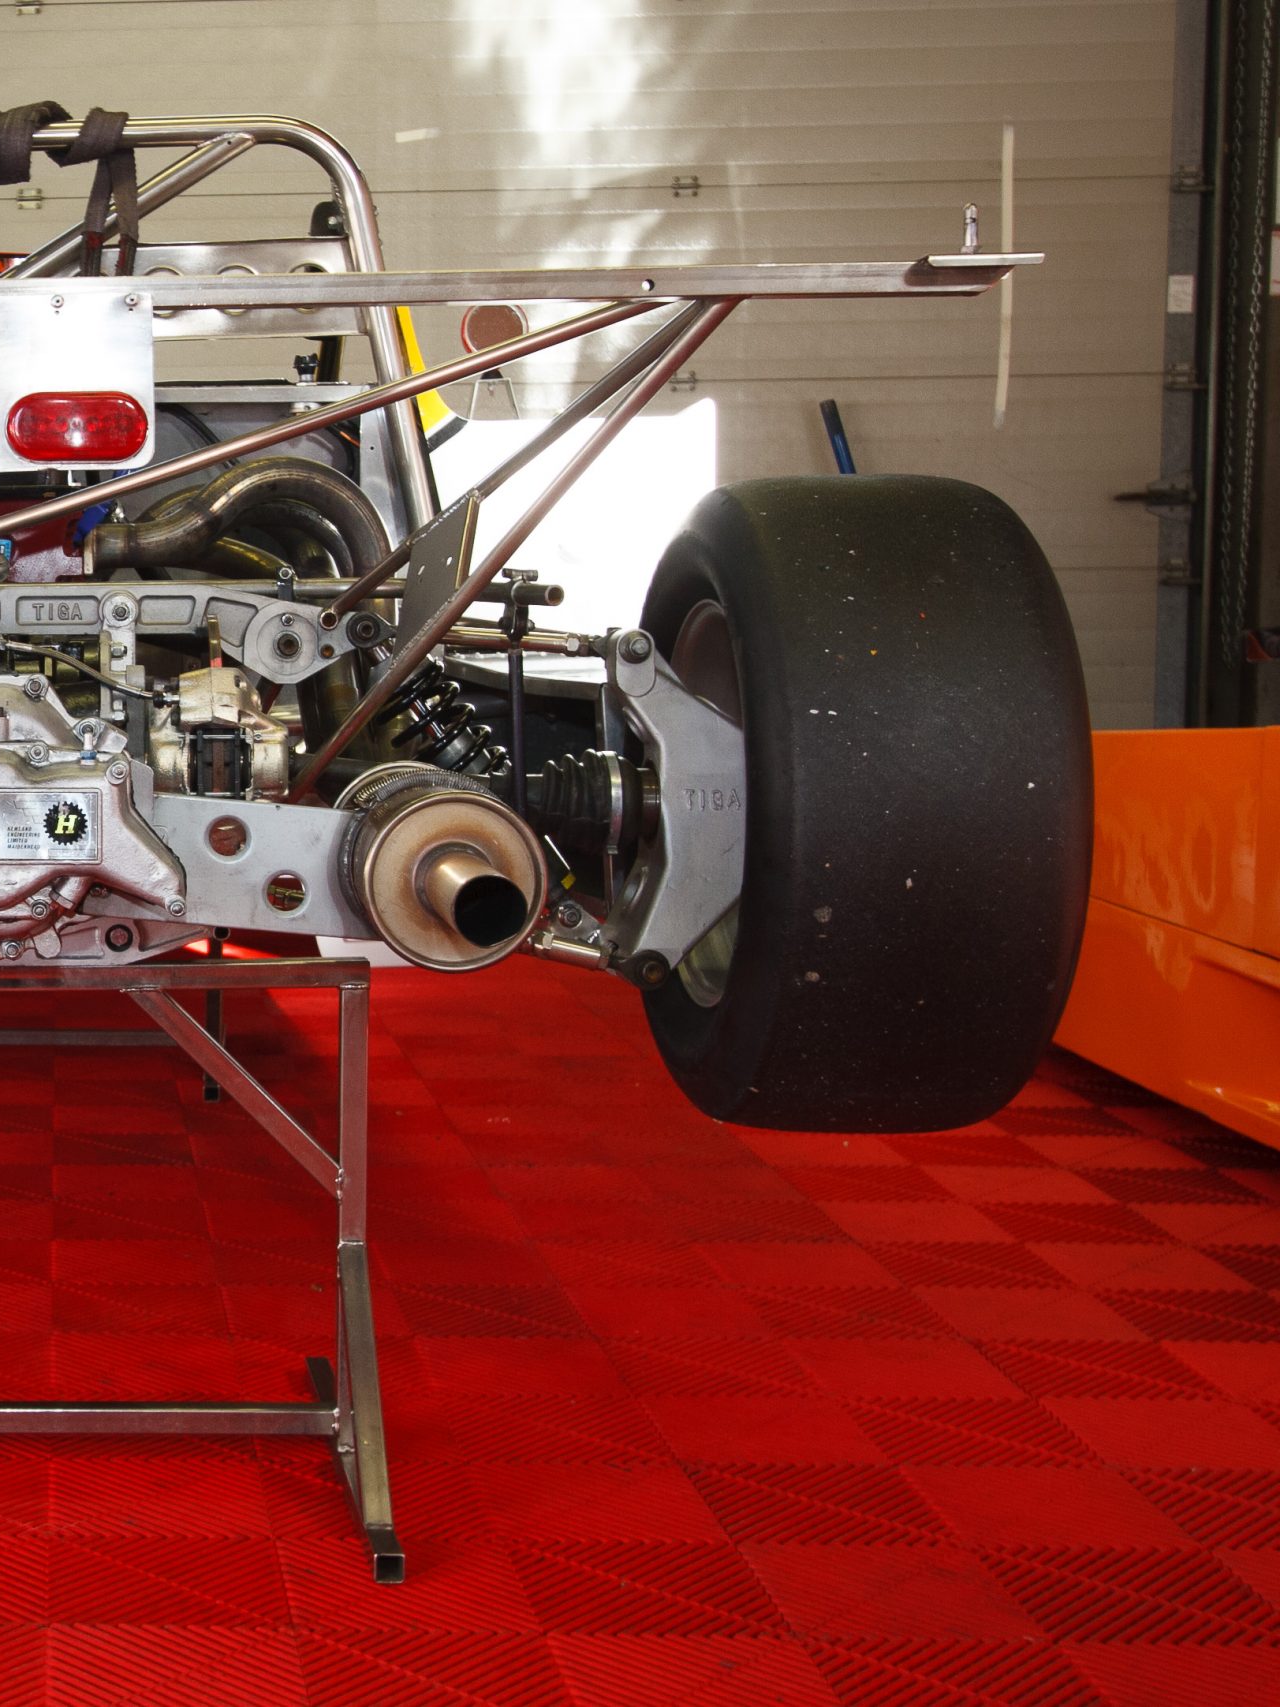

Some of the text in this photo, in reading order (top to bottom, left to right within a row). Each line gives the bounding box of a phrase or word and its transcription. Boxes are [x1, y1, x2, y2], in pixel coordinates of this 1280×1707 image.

[32, 602, 83, 621] TIGA
[682, 788, 741, 811] TIGA
[54, 814, 78, 834] H
